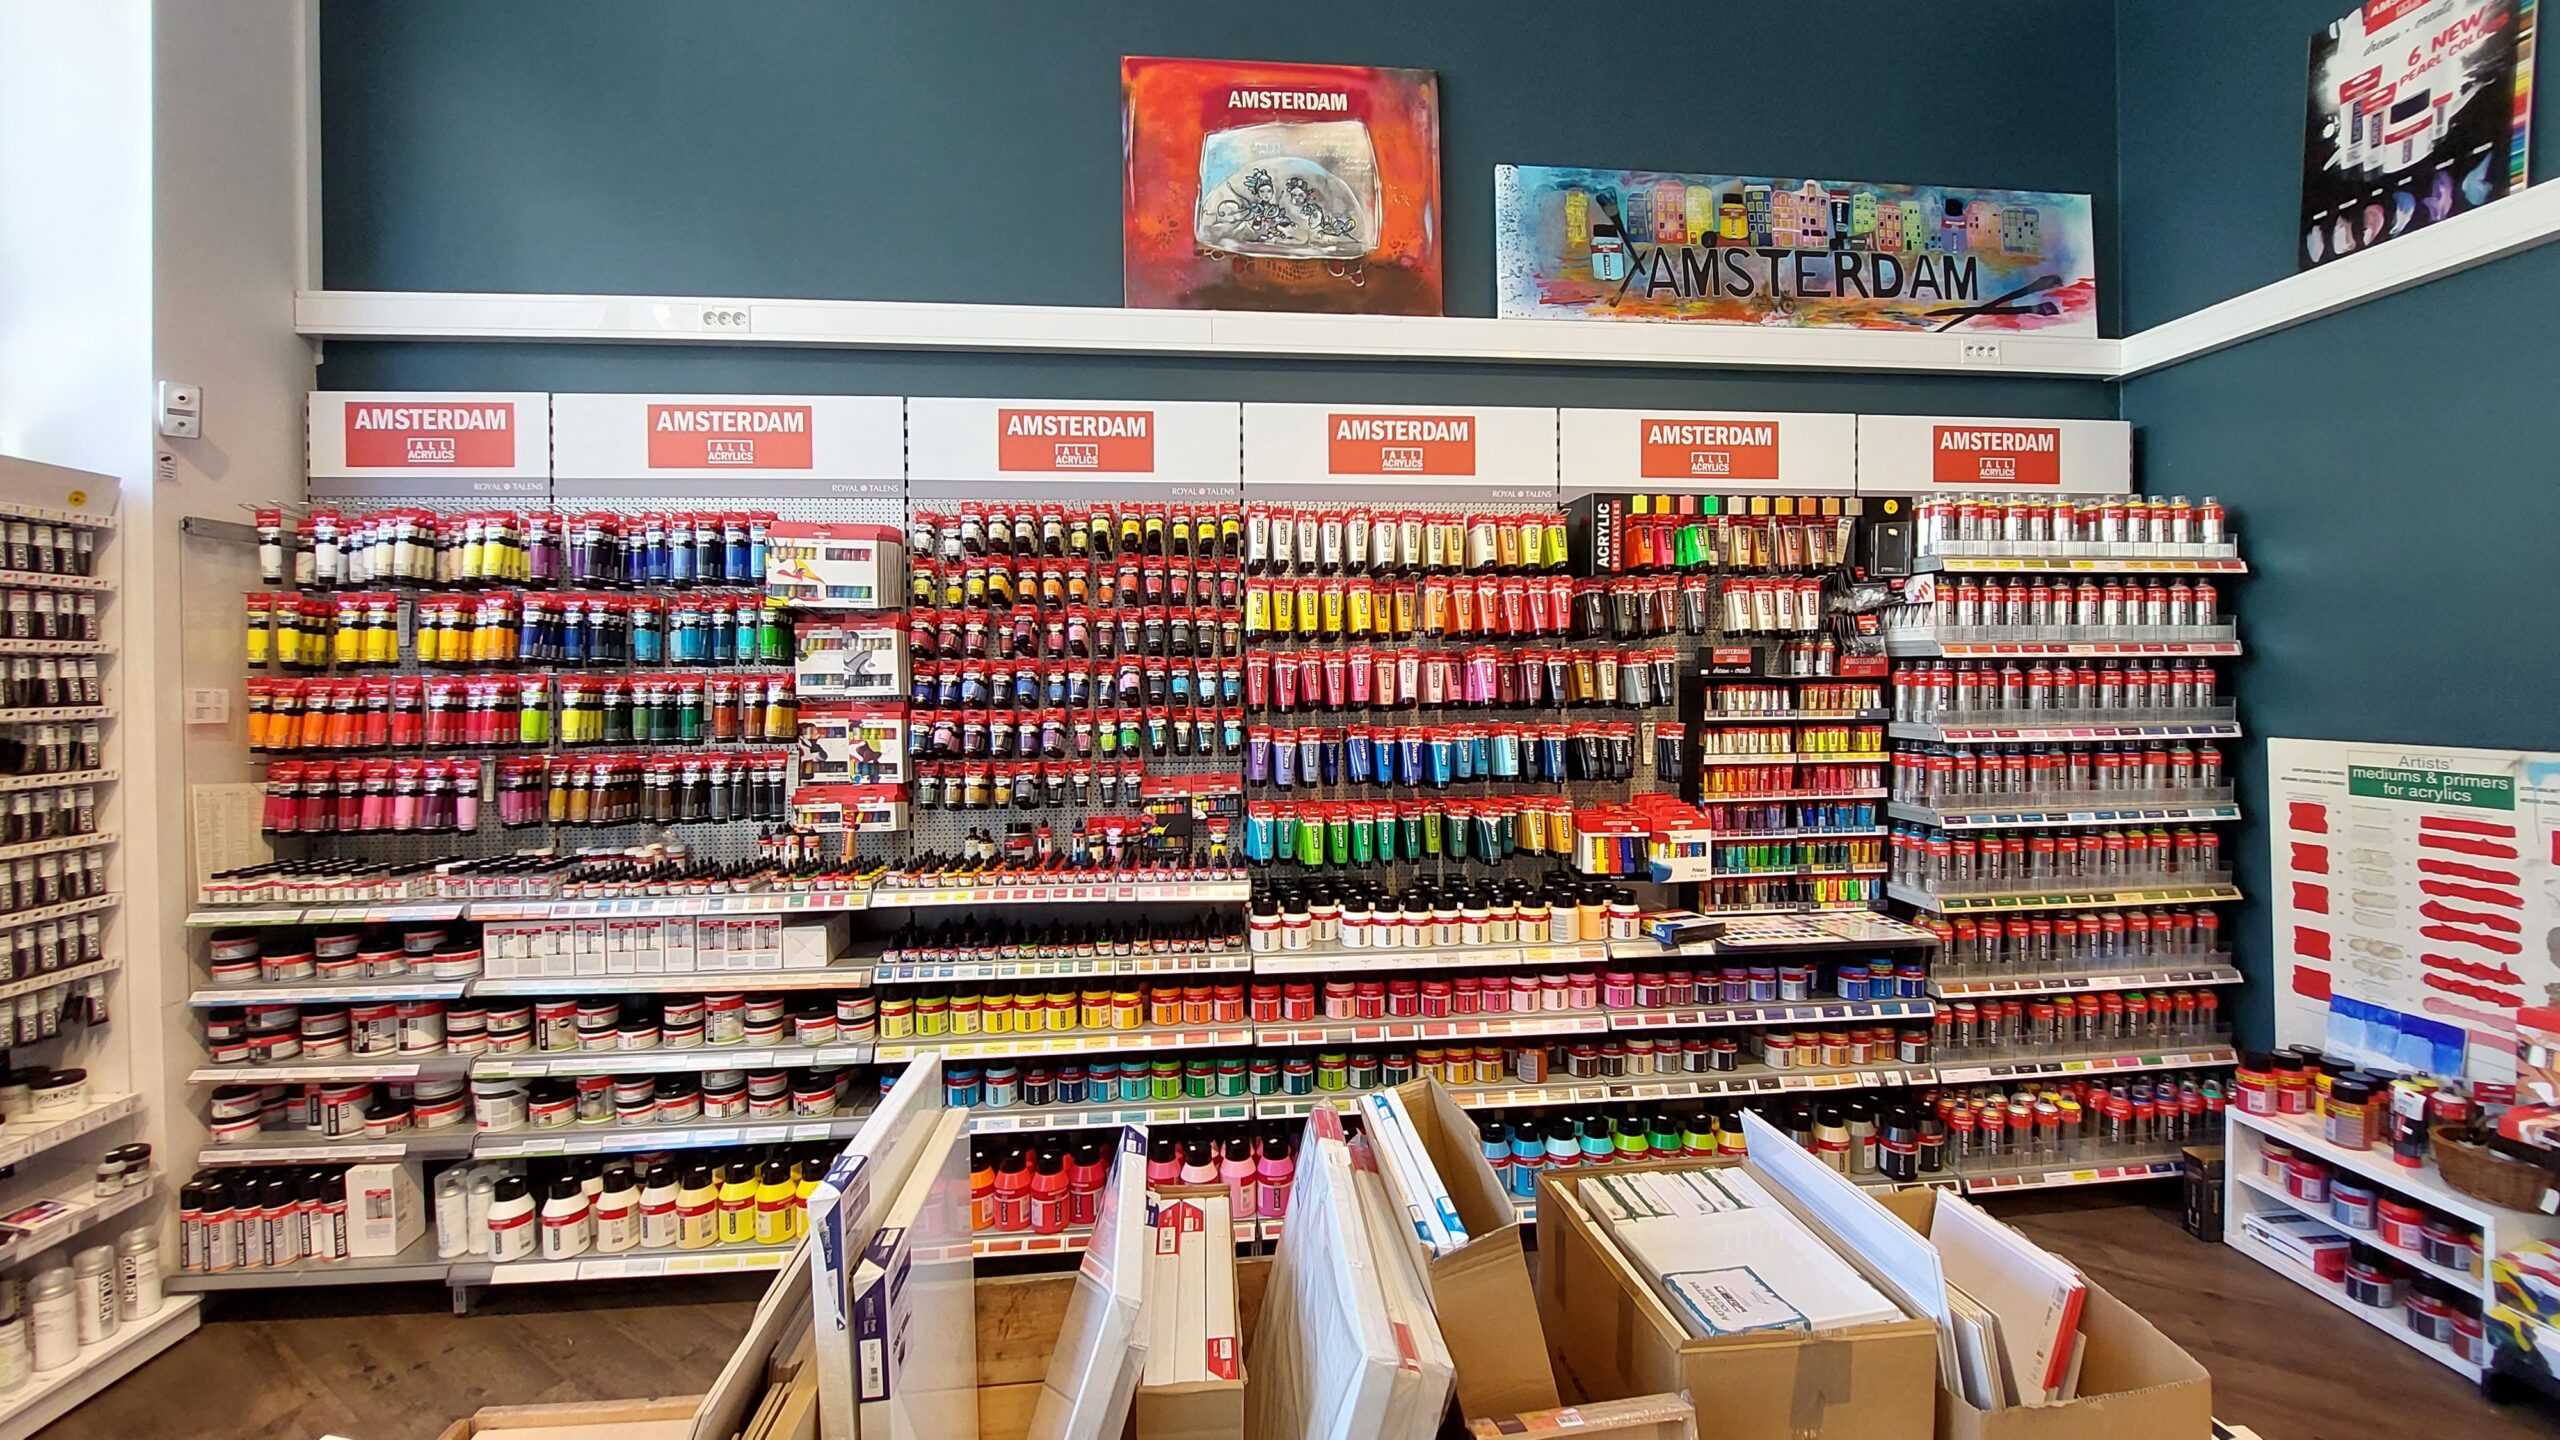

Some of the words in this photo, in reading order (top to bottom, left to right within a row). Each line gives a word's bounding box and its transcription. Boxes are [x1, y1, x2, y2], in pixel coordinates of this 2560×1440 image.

[2408, 45, 2422, 66] 6
[2432, 6, 2485, 53] NEW
[2400, 54, 2443, 87] PEARL
[1228, 90, 1348, 112] AMSTERDAM
[1645, 246, 1979, 300] AMSTERDAM
[355, 408, 506, 431] AMSTERDAM
[656, 411, 804, 433] AMSTERDAM
[1007, 416, 1146, 438] AMSTERDAM
[1336, 420, 1468, 441] AMSTERDAM
[1649, 425, 1772, 446] AMSTERDAM
[1940, 432, 2054, 452] AMSTERDAM
[416, 441, 448, 450] ALL
[715, 442, 746, 451] ALL
[1062, 447, 1092, 456] ALL
[408, 450, 455, 461] ACRYLICS
[708, 451, 754, 462] ACRYLICS
[1055, 455, 1098, 465] ACRYLICS
[1389, 451, 1418, 459] ALL
[1698, 455, 1724, 463] ALL
[1382, 458, 1423, 468] ACRYLICS
[1691, 462, 1730, 472] ACRYLICS
[1980, 468, 2015, 477] ACRYLICS
[474, 482, 501, 492] ROYAL
[512, 482, 544, 492] TALENS
[832, 484, 859, 493] ROYAL
[868, 484, 899, 493] TALENS
[1172, 488, 1197, 496] ROYAL
[1207, 488, 1235, 496] TALENS
[1492, 490, 1518, 498] ROYAL
[1525, 490, 1552, 498] TALENS
[1597, 503, 1610, 568] ACRYLIC
[2398, 756, 2454, 770] Artists'
[2352, 768, 2422, 783] mediums
[2426, 772, 2438, 784] &
[2444, 774, 2509, 790] primers
[2383, 783, 2403, 796] for
[2408, 787, 2472, 802] acrylics
[124, 1257, 136, 1302] GOLDEN
[100, 1273, 114, 1320] GOLDEN
